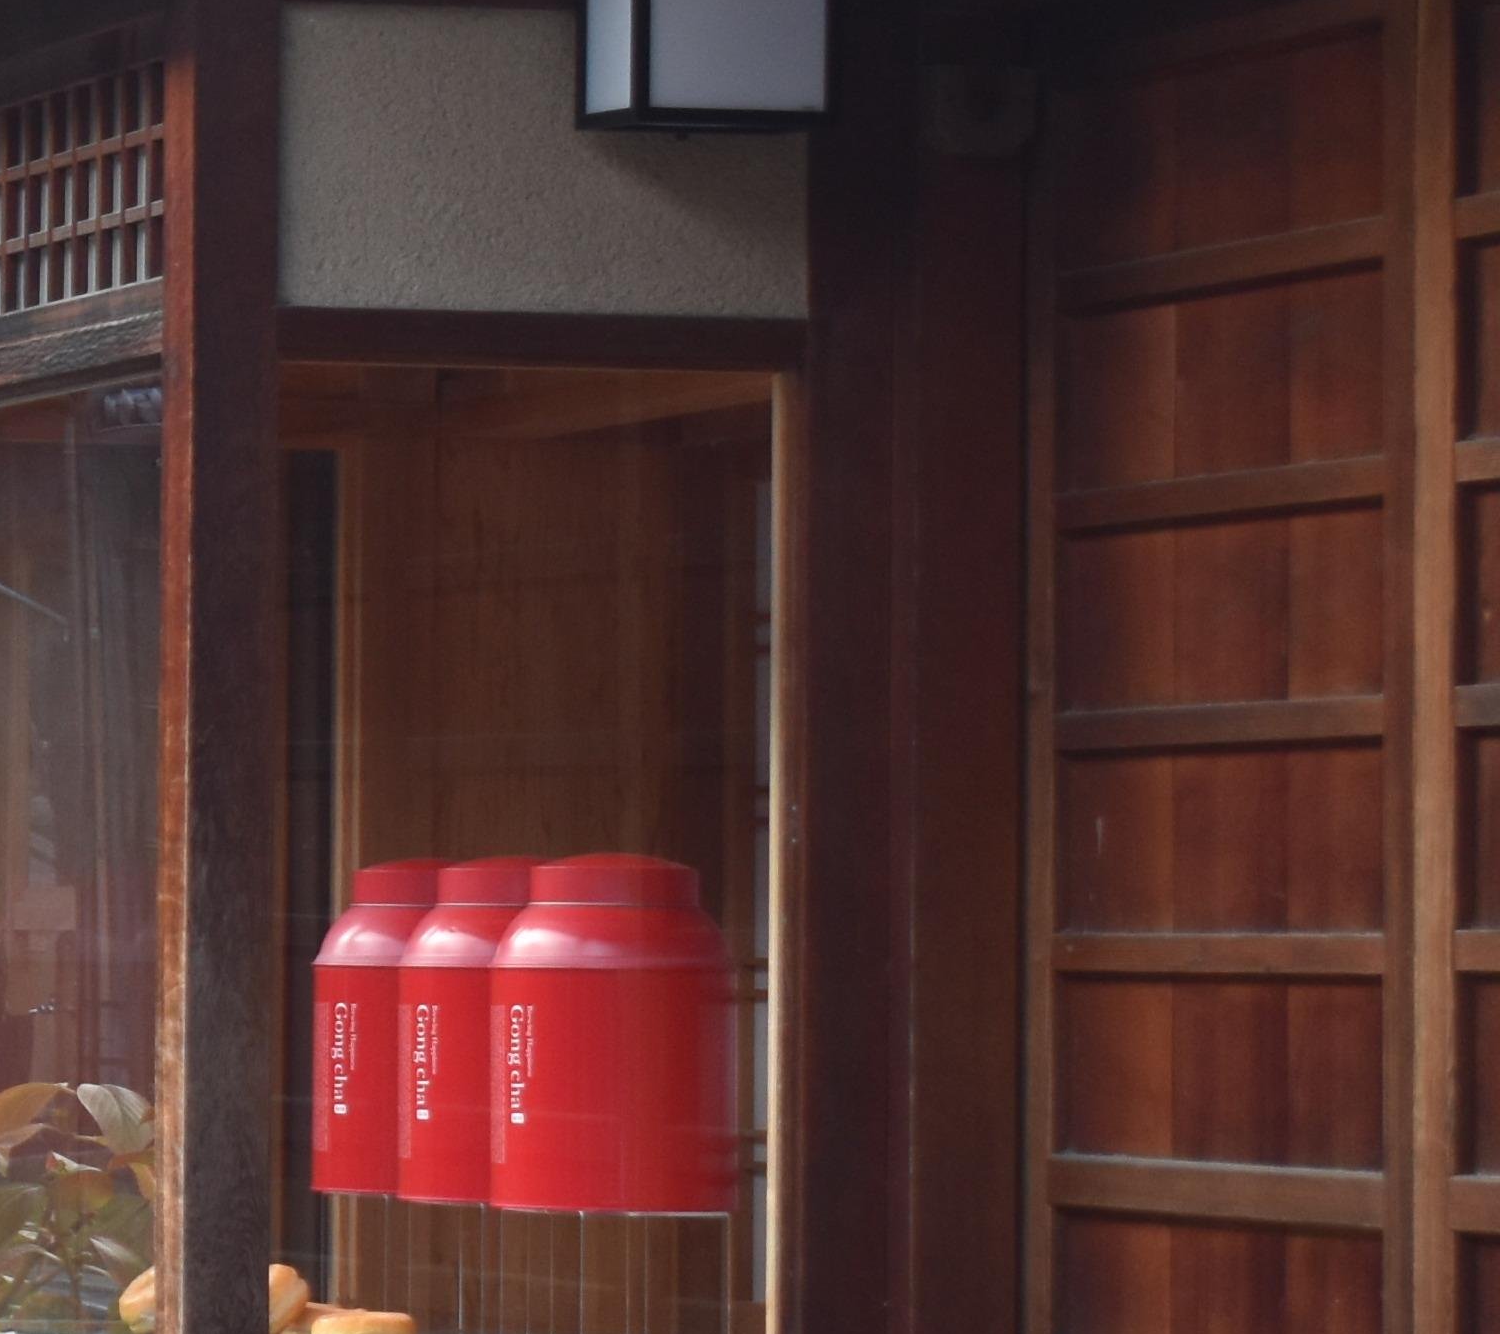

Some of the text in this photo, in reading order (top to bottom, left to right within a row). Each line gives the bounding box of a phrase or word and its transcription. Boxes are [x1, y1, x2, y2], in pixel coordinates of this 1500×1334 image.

[331, 1002, 348, 1059] Gong
[413, 1004, 429, 1064] Gong
[507, 1004, 524, 1065] Gong
[334, 1063, 348, 1100] cha
[416, 1068, 430, 1105] cha
[510, 1070, 525, 1109] cha
